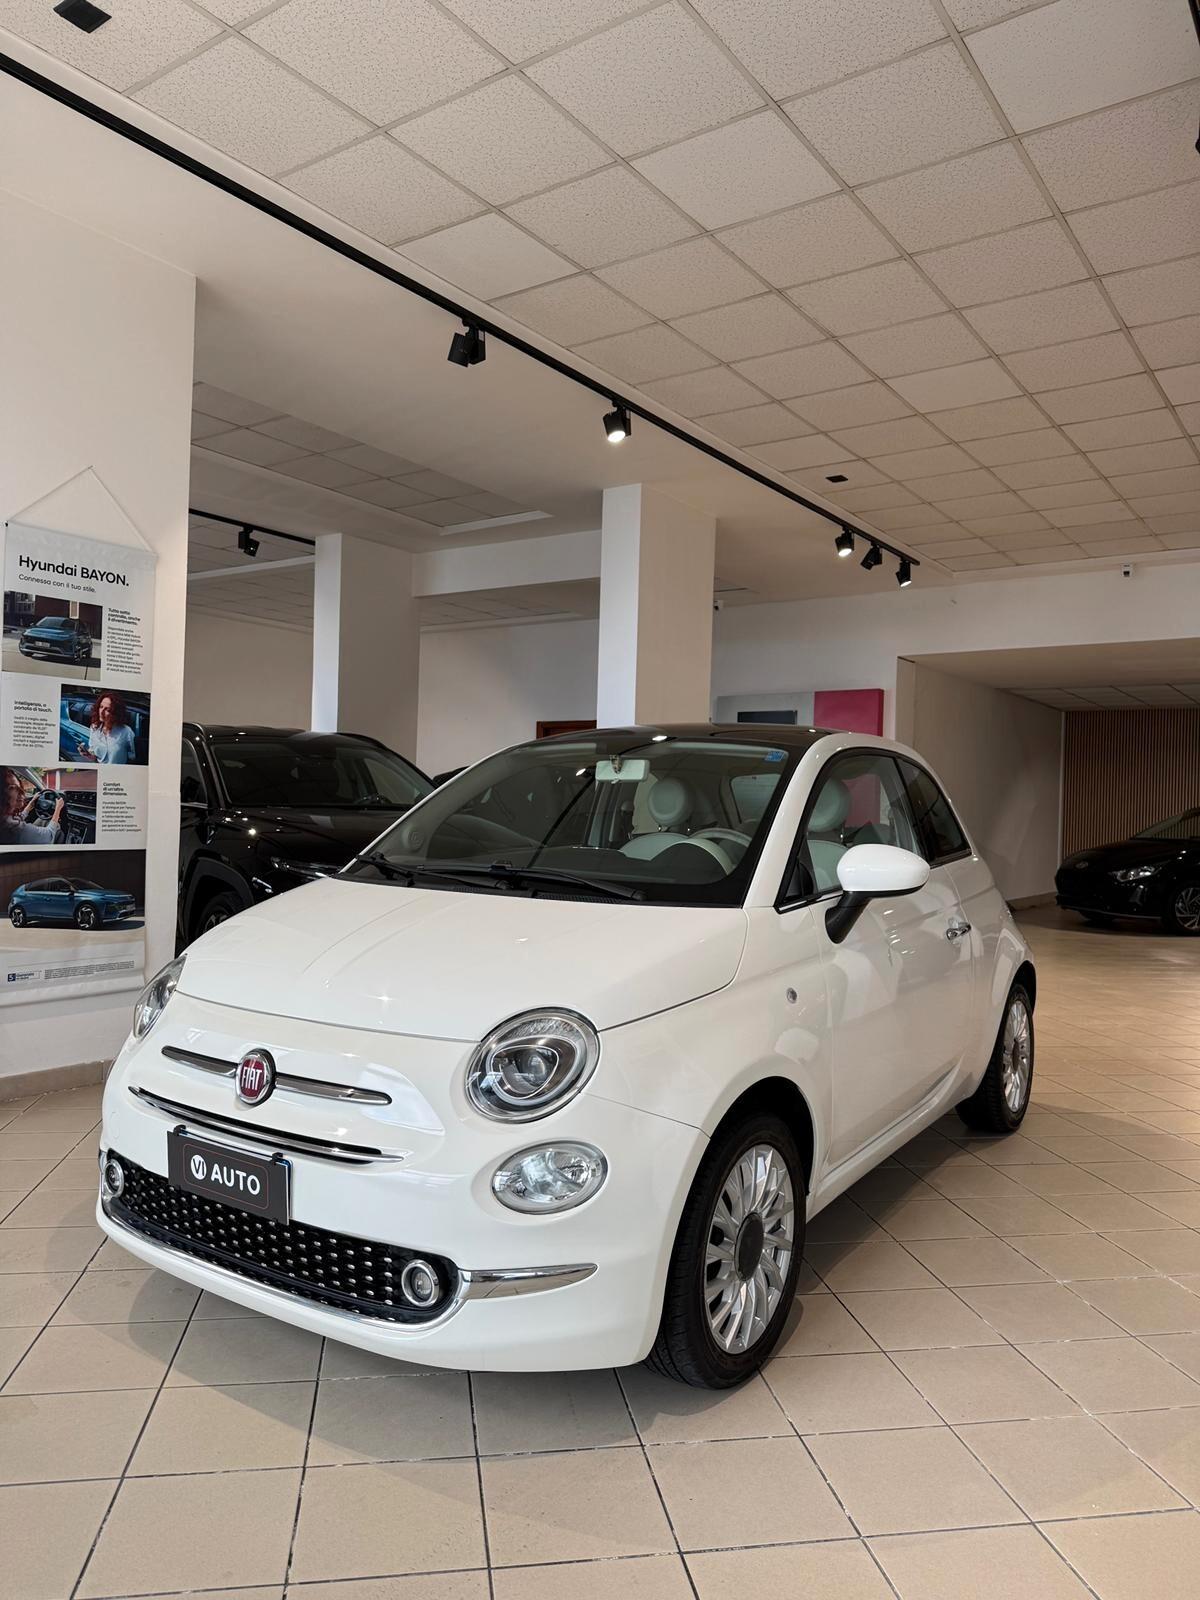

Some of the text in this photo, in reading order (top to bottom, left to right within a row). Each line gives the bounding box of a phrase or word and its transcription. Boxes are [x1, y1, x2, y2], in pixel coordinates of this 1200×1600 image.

[18, 555, 129, 586] Hyundai BAYON.
[18, 574, 52, 585] Connessa
[52, 580, 65, 588] con
[71, 583, 82, 591] tuo
[242, 1066, 263, 1091] FIAT
[210, 1164, 261, 1195] AUTO
